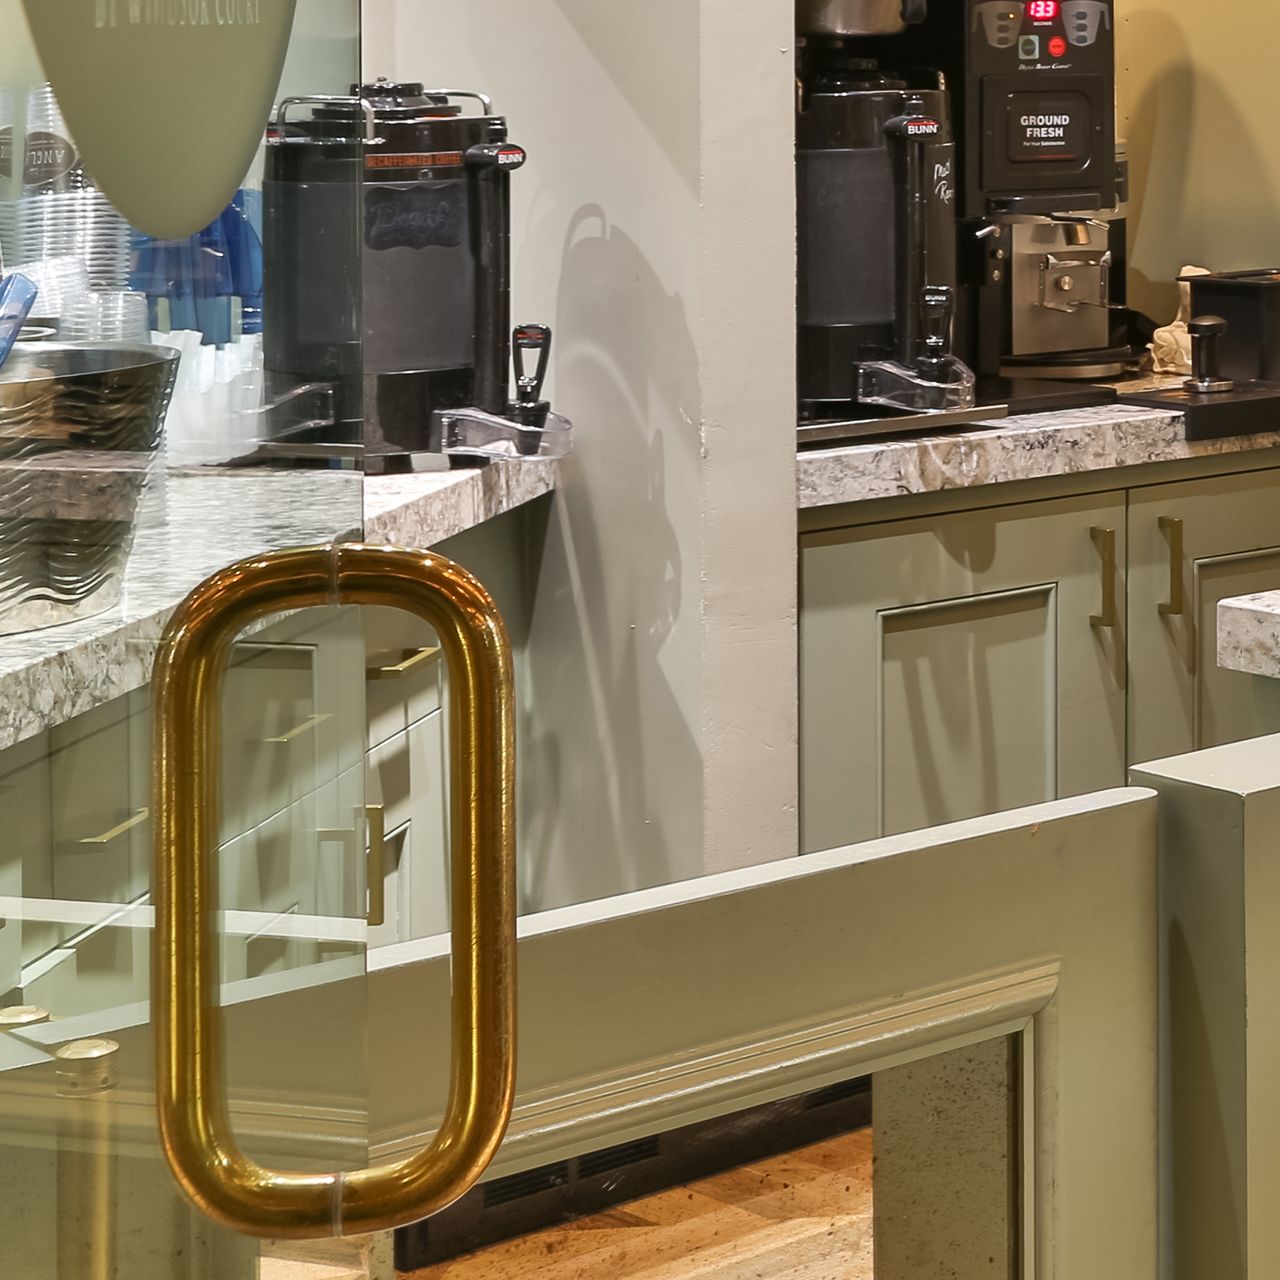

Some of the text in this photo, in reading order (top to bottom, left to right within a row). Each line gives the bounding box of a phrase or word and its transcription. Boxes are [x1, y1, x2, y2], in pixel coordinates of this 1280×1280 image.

[1020, 115, 1070, 126] GROUND
[907, 124, 939, 135] BUNN
[1026, 127, 1064, 138] FRESH
